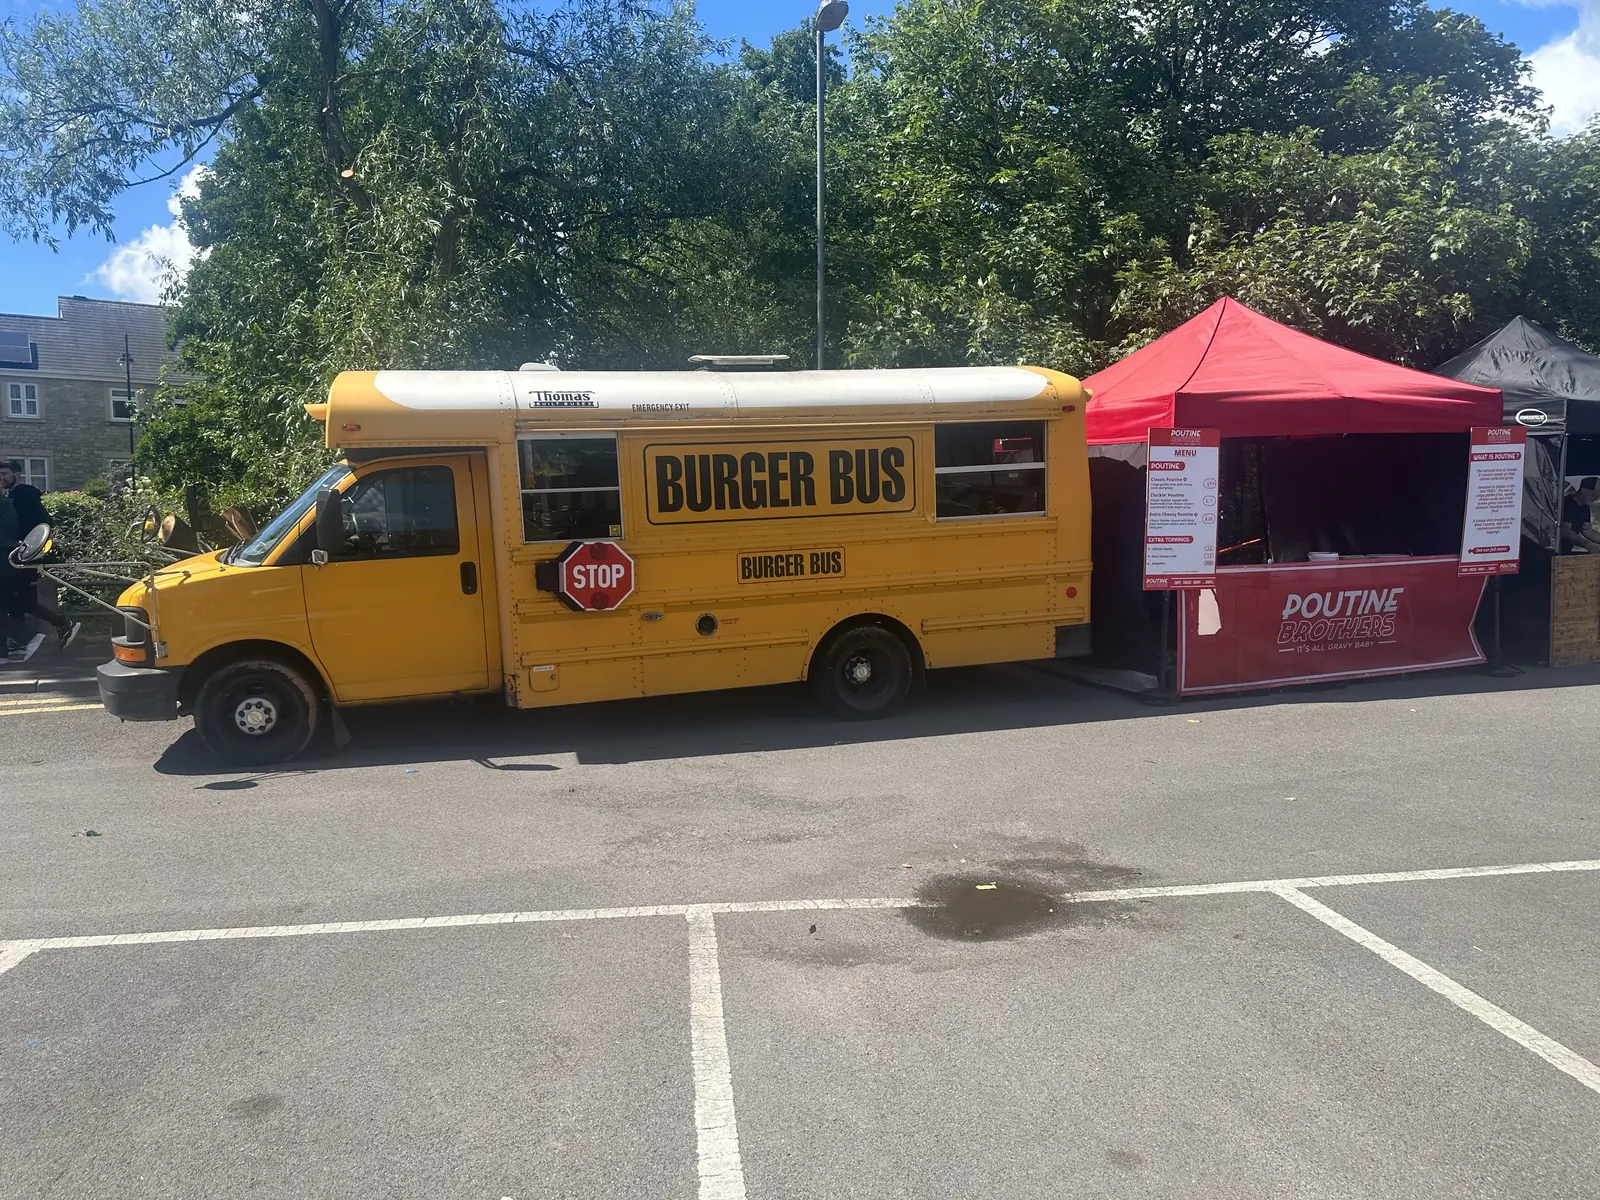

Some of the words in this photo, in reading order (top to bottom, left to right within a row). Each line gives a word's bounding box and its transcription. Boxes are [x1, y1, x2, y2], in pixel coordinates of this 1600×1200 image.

[536, 391, 591, 401] Thomas
[632, 404, 674, 412] EMERGENCY
[675, 403, 690, 411] EXIT
[1174, 449, 1197, 457] MENU
[655, 451, 816, 513] BURGER
[828, 447, 906, 505] BUS
[572, 564, 625, 589] STOP
[740, 554, 805, 580] BURGER
[810, 551, 842, 575] BUS
[1282, 588, 1404, 619] POUTINE
[1277, 613, 1396, 644] BROTHERS
[1297, 645, 1310, 653] IT'S
